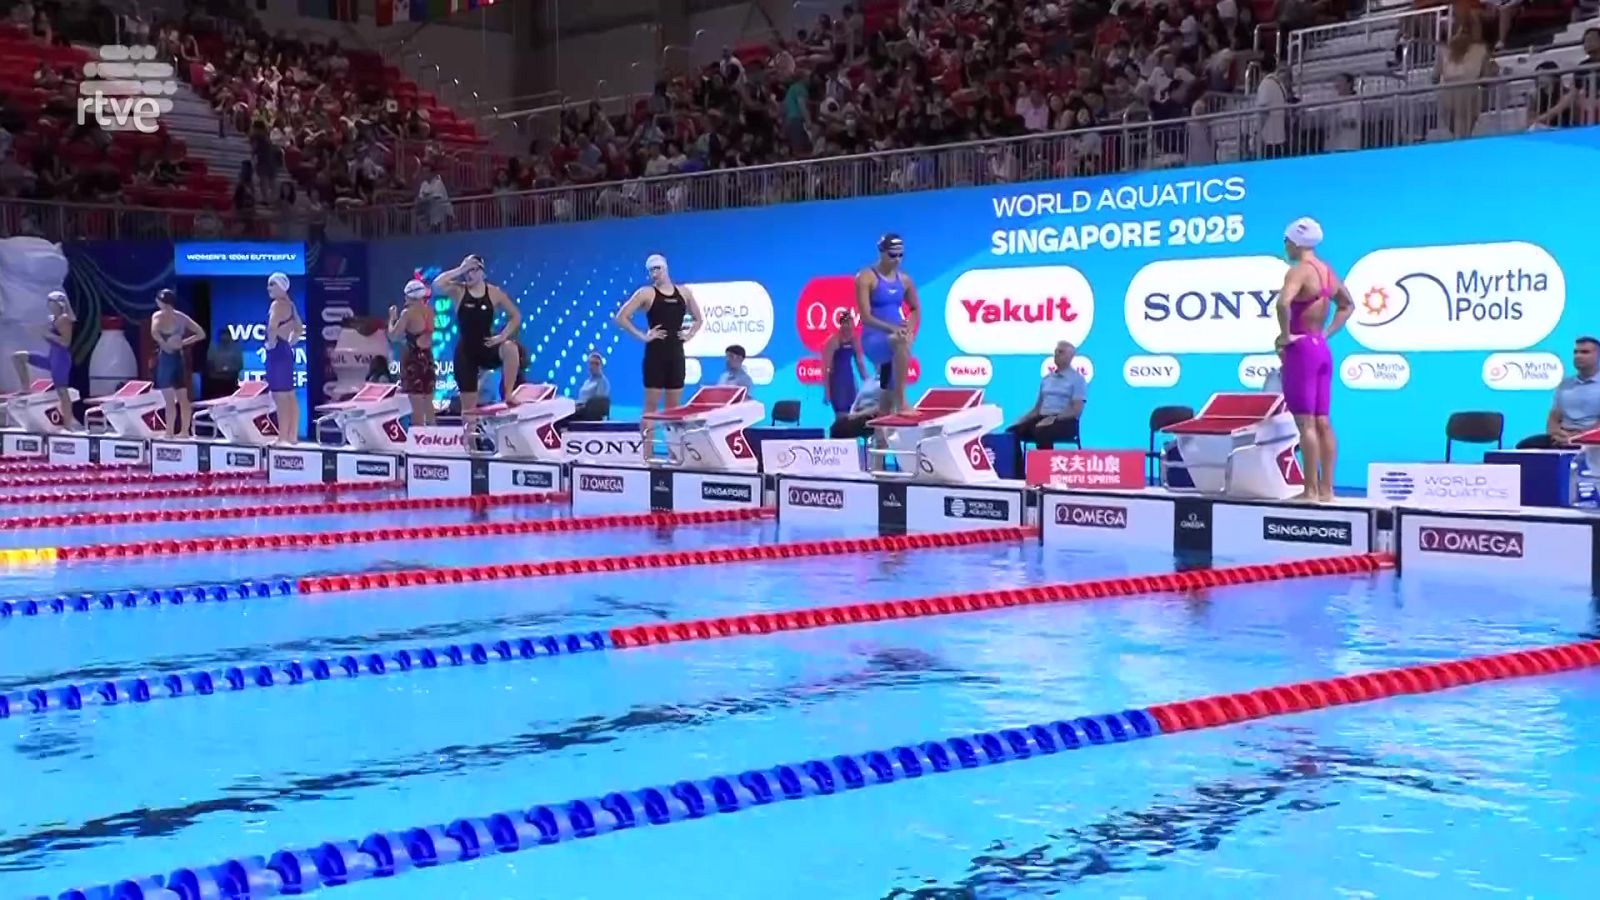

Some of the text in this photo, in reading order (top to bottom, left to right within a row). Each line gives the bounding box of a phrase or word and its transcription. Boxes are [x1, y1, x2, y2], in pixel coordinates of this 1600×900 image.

[992, 176, 1247, 218] WORLD AQUATICS
[991, 214, 1245, 256] SINGAPORE 2025
[1456, 268, 1548, 299] Myrtha
[703, 305, 749, 318] WORLD
[960, 296, 1078, 324] Yakult
[1144, 290, 1280, 322] SONY
[1456, 297, 1524, 321] Pools
[704, 319, 766, 333] AQUATICS
[951, 366, 987, 376] Yakult
[1130, 366, 1174, 377] SONY
[261, 419, 271, 434] 2
[390, 424, 399, 440] 3
[544, 430, 554, 446] 4
[733, 438, 743, 454] 5
[566, 440, 644, 455] SONY
[970, 444, 981, 465] 6
[1050, 455, 1120, 473] 农夫山泉
[1283, 455, 1294, 479] 7
[589, 477, 624, 491] OMEGA
[1424, 475, 1487, 486] WORLD
[802, 489, 844, 506] OMEGA
[1424, 487, 1508, 498] AQUATICS
[1072, 507, 1127, 526] OMEGA
[1267, 523, 1348, 540] SINGAPORE
[1444, 532, 1522, 554] OMEGA
